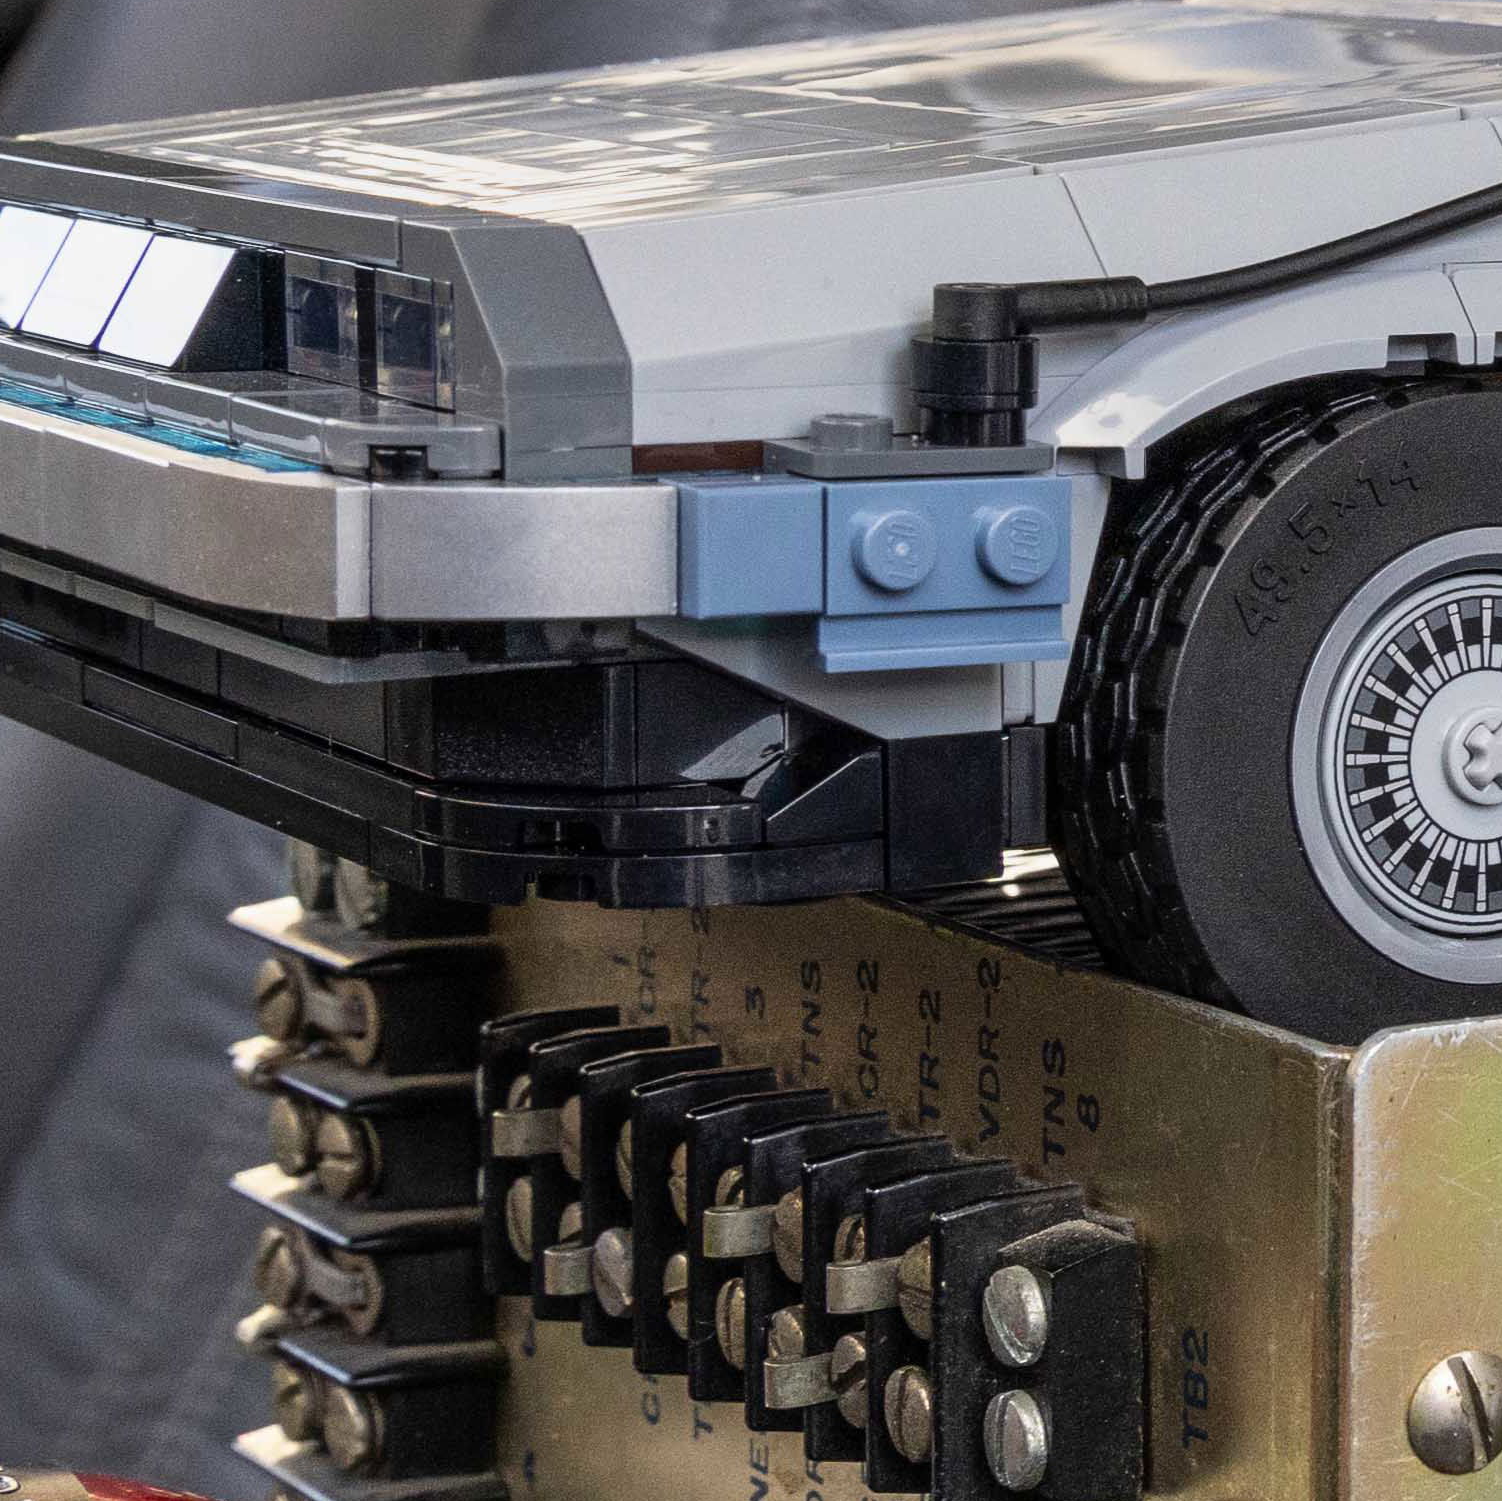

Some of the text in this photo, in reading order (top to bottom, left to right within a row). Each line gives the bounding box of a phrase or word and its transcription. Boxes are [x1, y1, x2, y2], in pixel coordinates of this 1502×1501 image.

[856, 960, 879, 1099] CR-2
[919, 989, 941, 1124] TR-2
[977, 958, 1001, 1142] VDR-2
[1042, 1039, 1066, 1165] TNS
[1181, 1328, 1209, 1448] TB2
